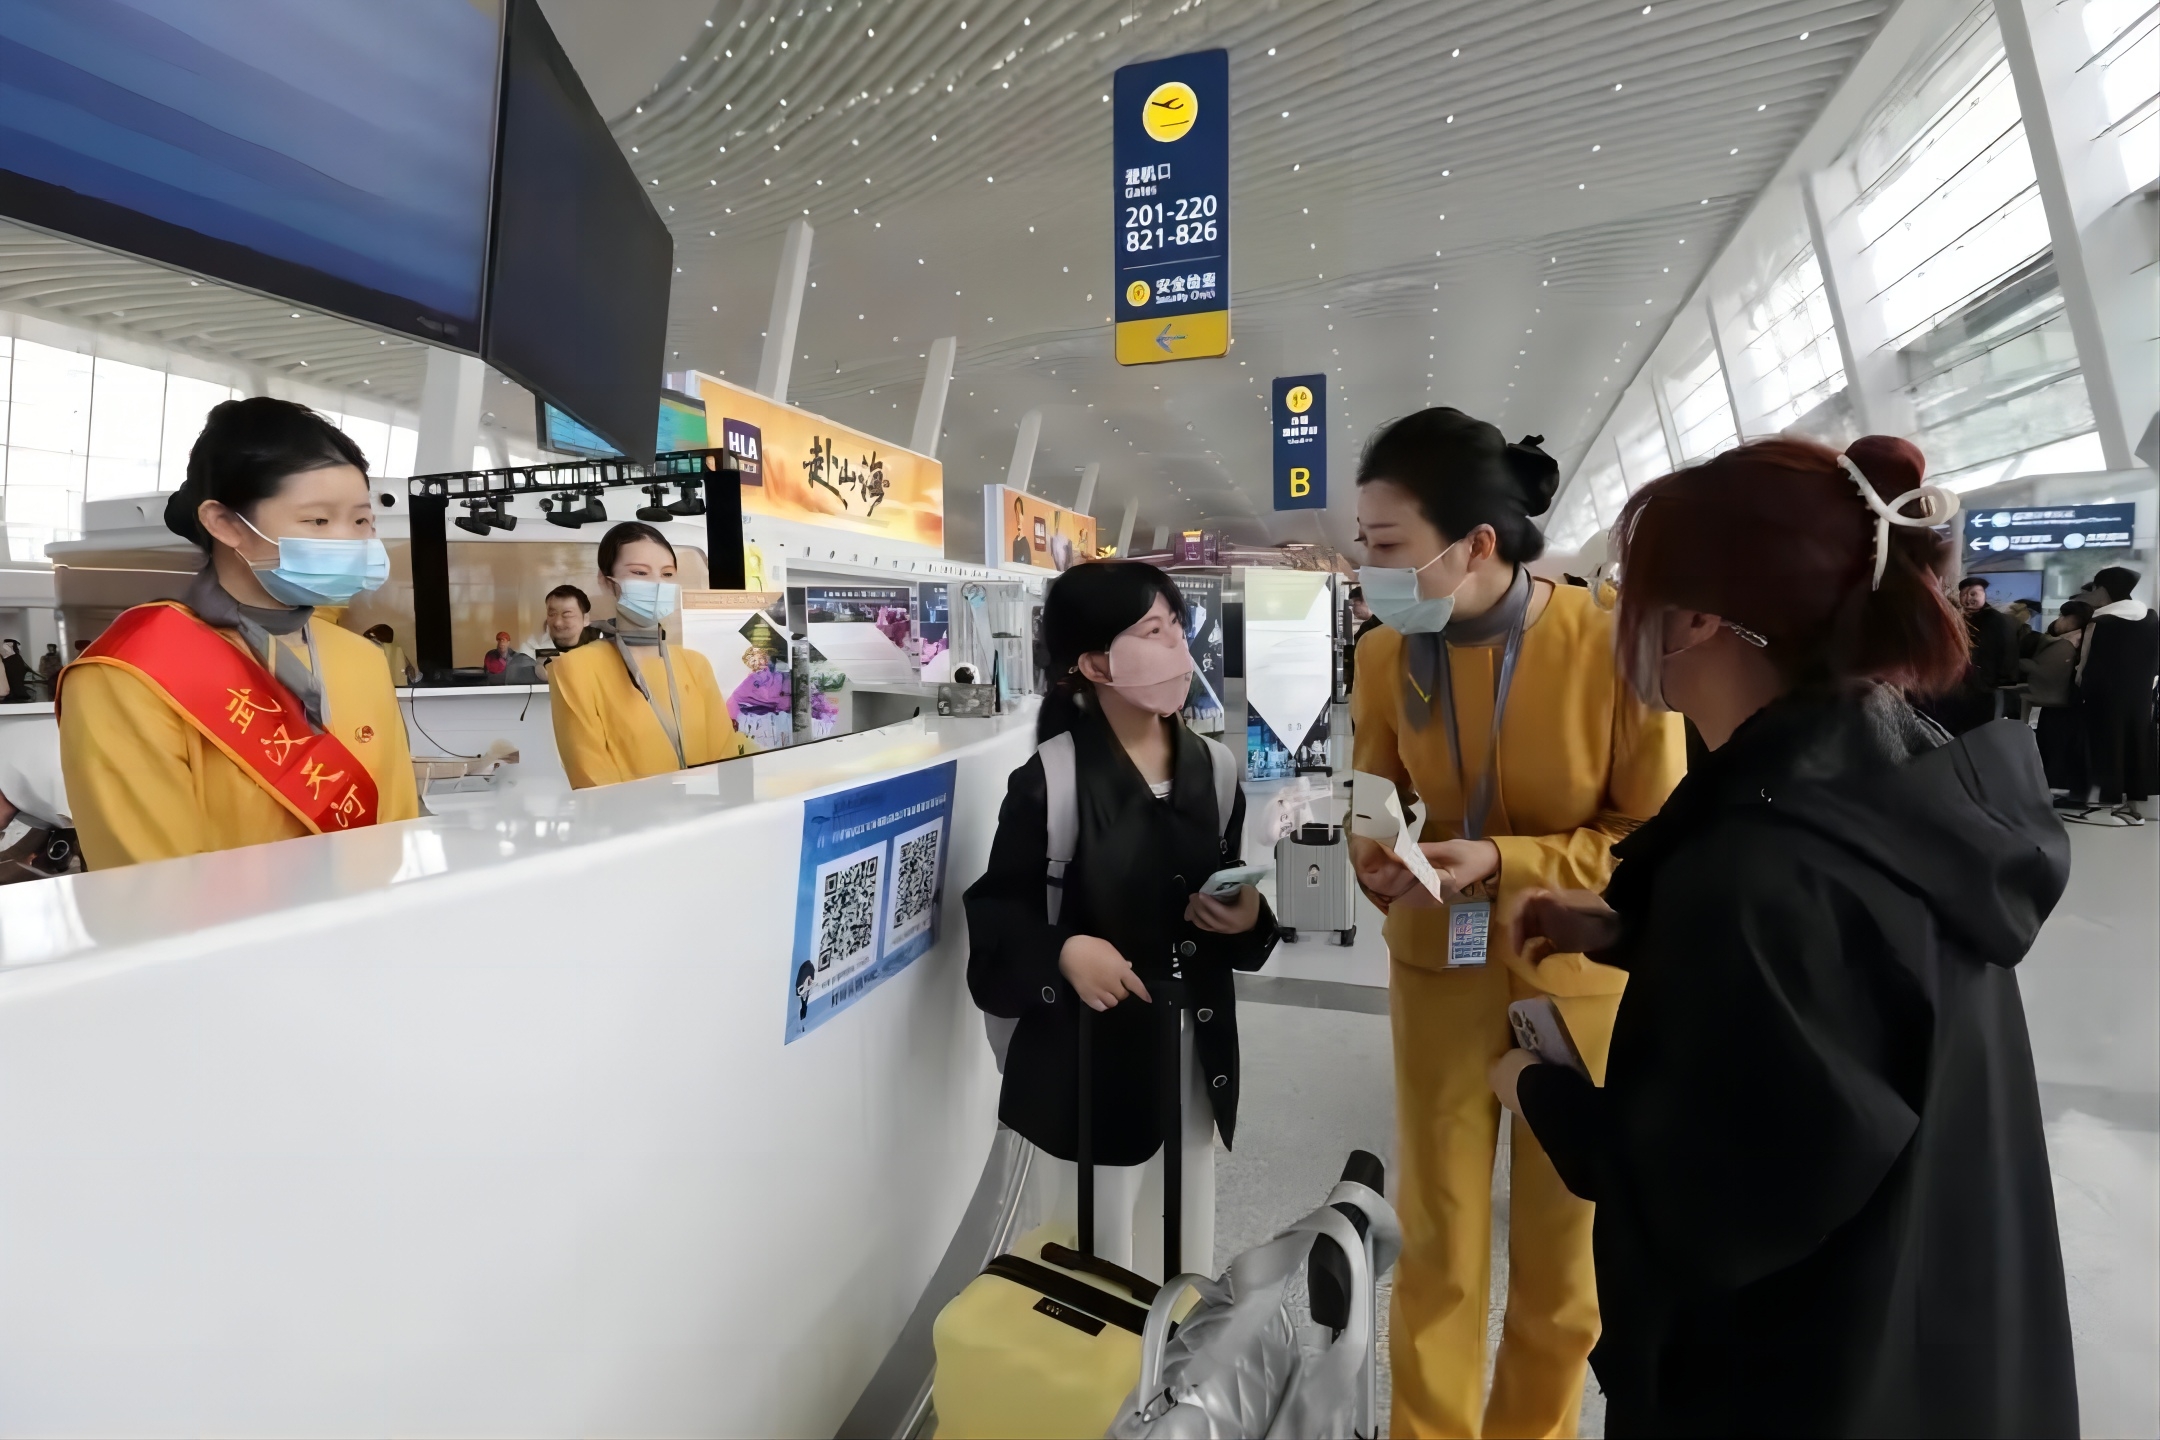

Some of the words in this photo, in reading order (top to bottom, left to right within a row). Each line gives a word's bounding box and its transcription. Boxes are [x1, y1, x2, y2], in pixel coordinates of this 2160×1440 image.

[1125, 195, 1218, 228] 201-220
[1126, 219, 1218, 252] 821-826
[728, 431, 758, 460] HLA
[802, 435, 890, 517] 赴山海
[1290, 467, 1311, 497] B
[225, 687, 366, 828] 武汉天河
